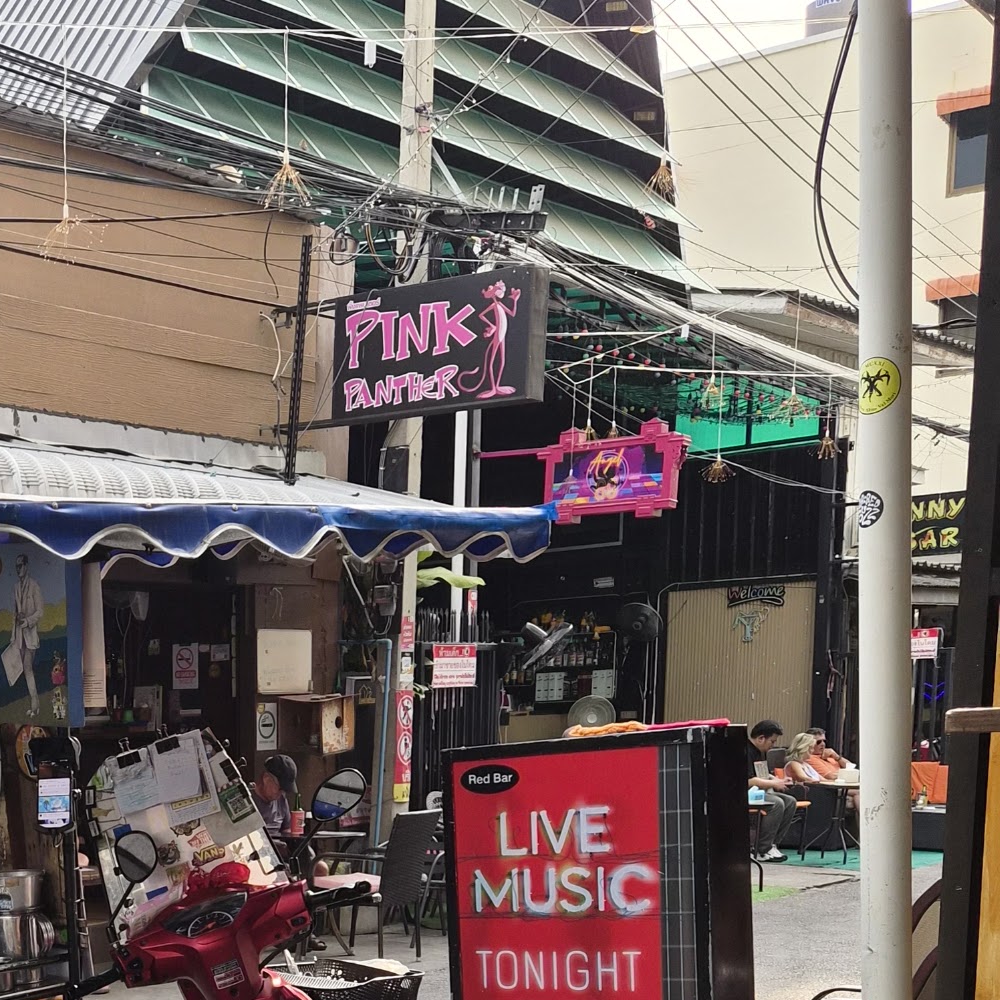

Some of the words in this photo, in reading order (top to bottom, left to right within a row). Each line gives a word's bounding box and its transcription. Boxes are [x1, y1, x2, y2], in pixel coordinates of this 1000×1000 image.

[345, 301, 477, 369] PINK
[343, 365, 460, 412] PANTHER
[588, 447, 625, 477] Angel
[728, 585, 785, 600] Welcome
[468, 774, 491, 785] Red
[493, 773, 513, 784] Bar
[498, 805, 613, 857] LIVE
[474, 864, 654, 914] MUSIC
[475, 950, 642, 992] TONIGHT
